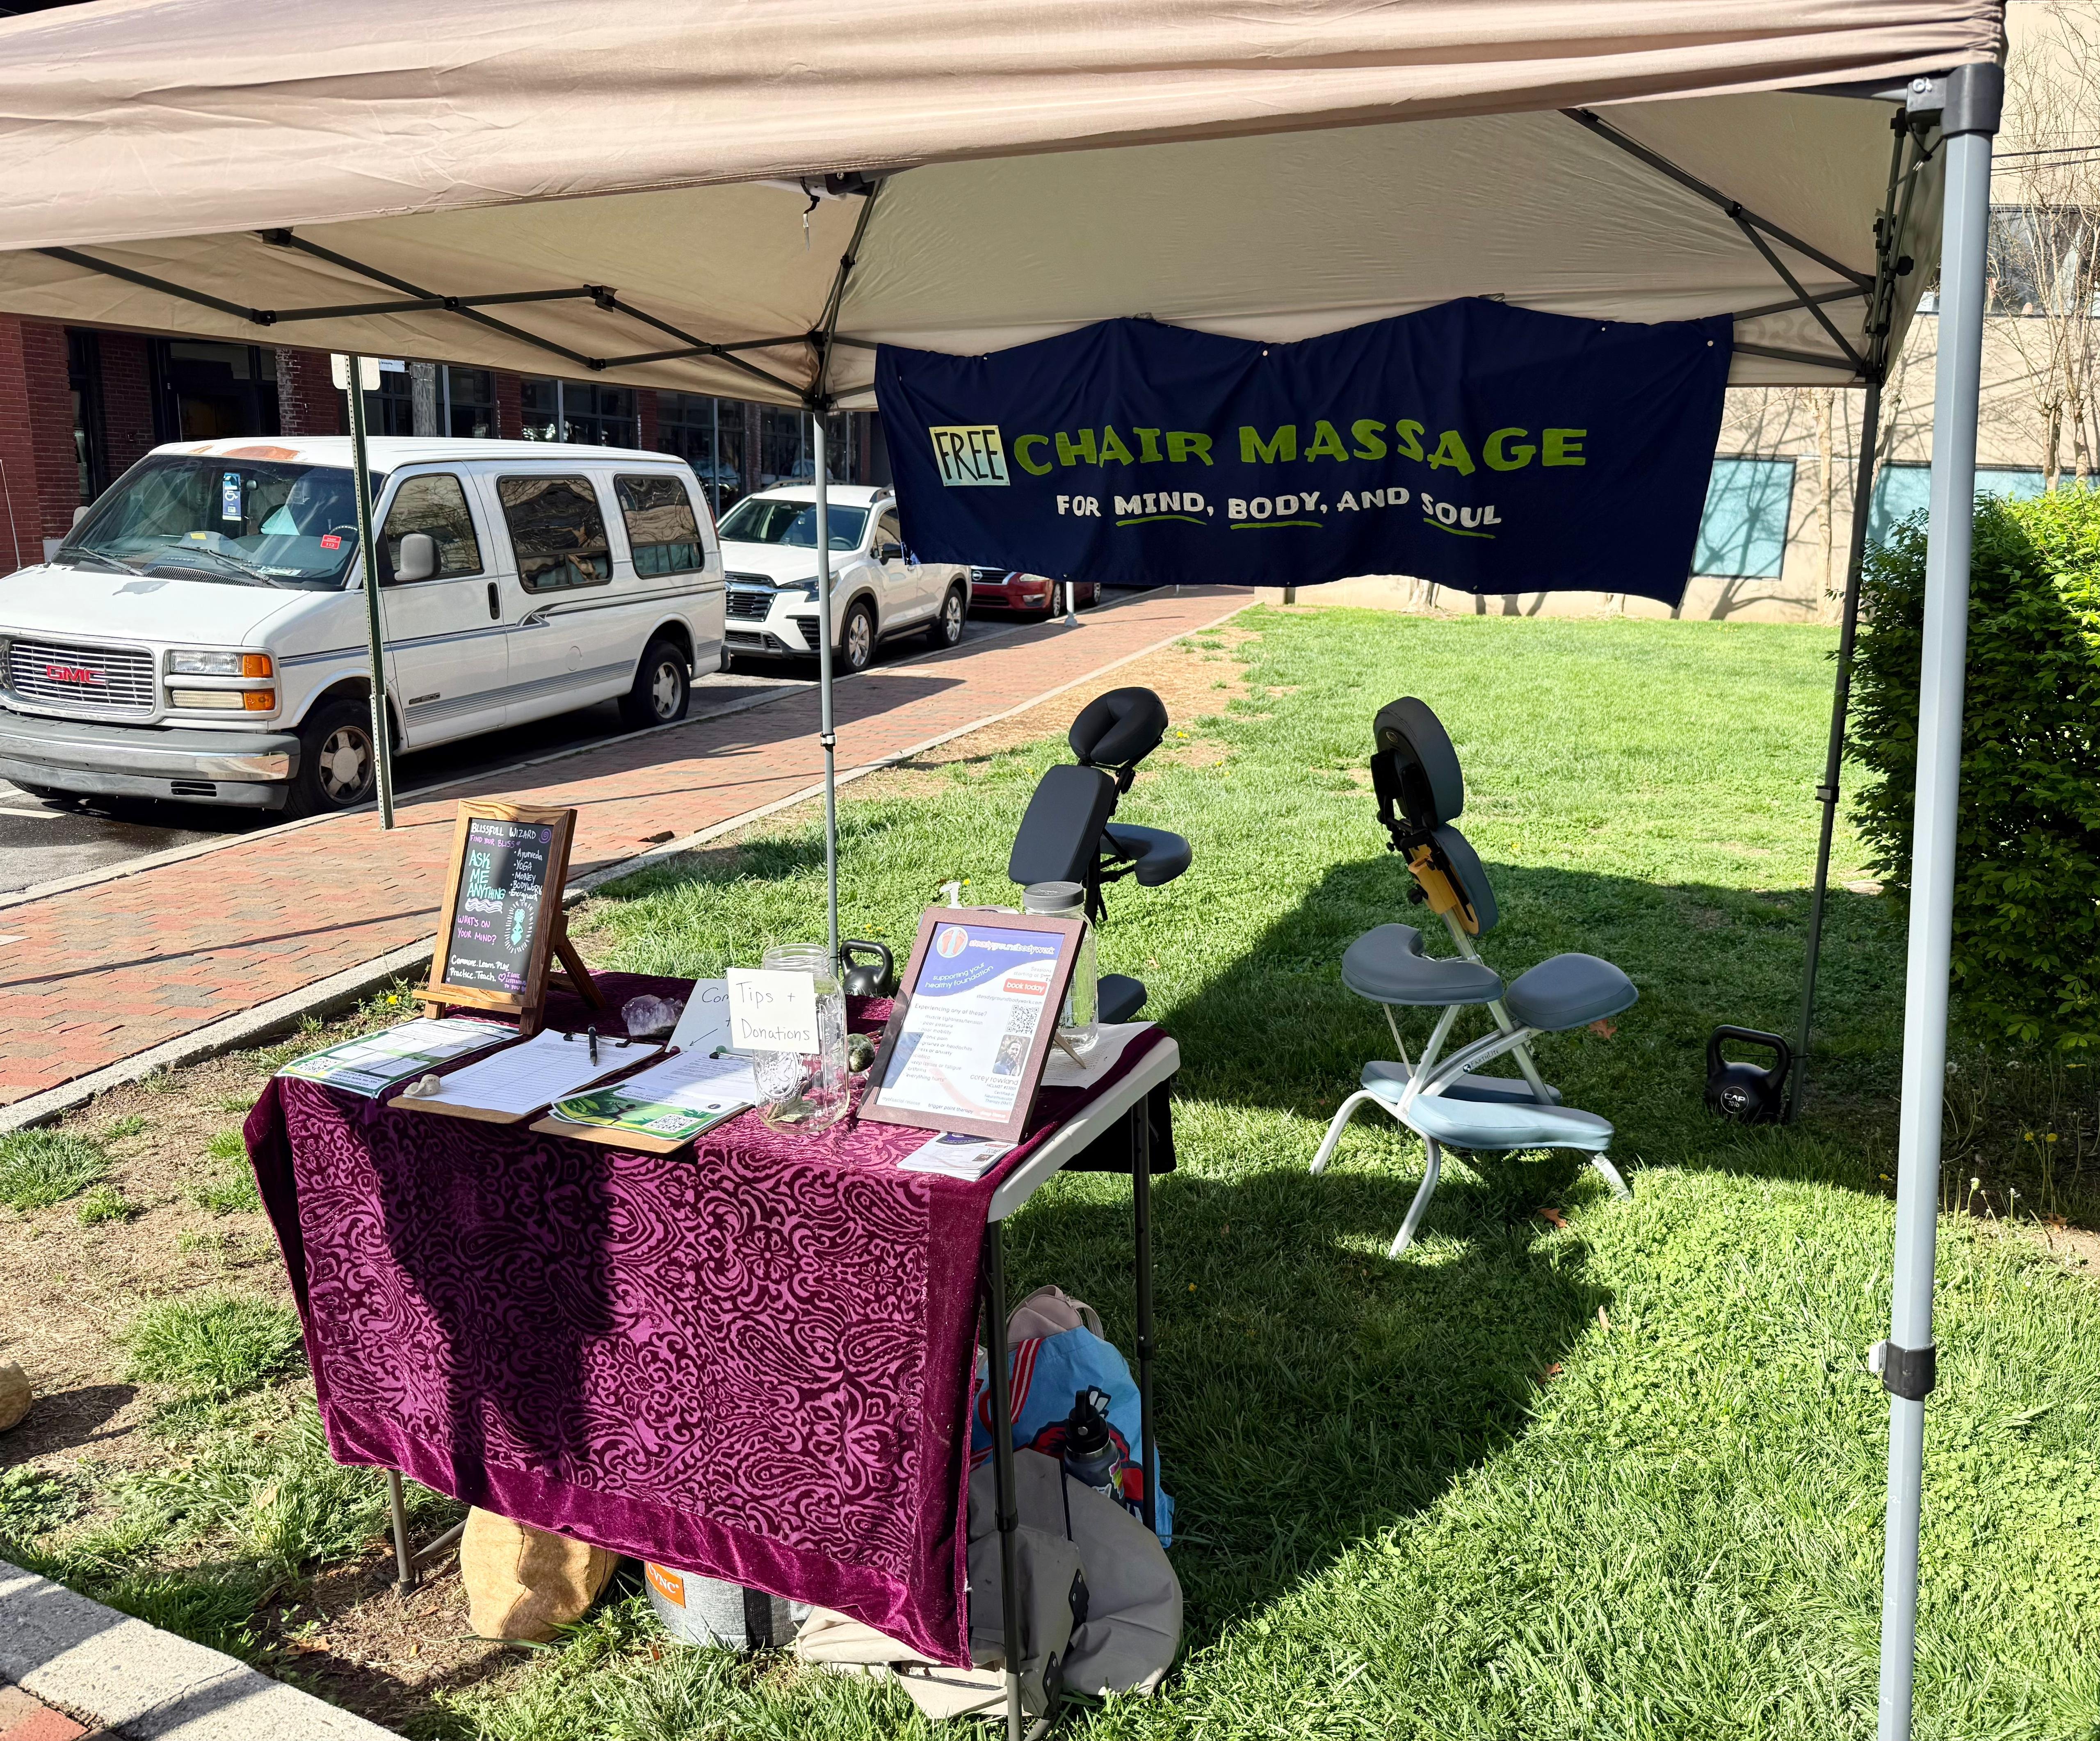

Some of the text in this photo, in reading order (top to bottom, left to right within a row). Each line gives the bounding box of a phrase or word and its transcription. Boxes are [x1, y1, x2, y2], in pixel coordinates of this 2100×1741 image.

[934, 430, 1004, 481] FREE
[1014, 419, 1587, 476] CHAIR MASSAGE
[1057, 487, 1502, 528] FOR MIND, BODY, AND SOUL
[46, 665, 107, 685] GMC
[470, 834, 515, 848] FIND YOUR BLISS
[509, 827, 536, 839] WIZARD
[469, 850, 491, 869] ASK
[517, 848, 542, 861] Ayurveda
[516, 859, 532, 871] YOGA
[470, 868, 490, 884] ME
[467, 882, 506, 900] ANYTHING
[510, 889, 538, 902] Energywork
[513, 880, 542, 895] BODYWORK
[458, 927, 497, 945] YOUR MIND?
[932, 962, 985, 981] supporting your
[954, 966, 994, 986] foundation
[736, 981, 796, 1009] Tips +
[1006, 981, 1045, 993] book today
[915, 1003, 950, 1013] Experiencing
[741, 1018, 810, 1041] Donations
[970, 1074, 1019, 1085] corey rowland
[1724, 1093, 1745, 1102] CAP
[648, 1562, 676, 1594] CVNC
